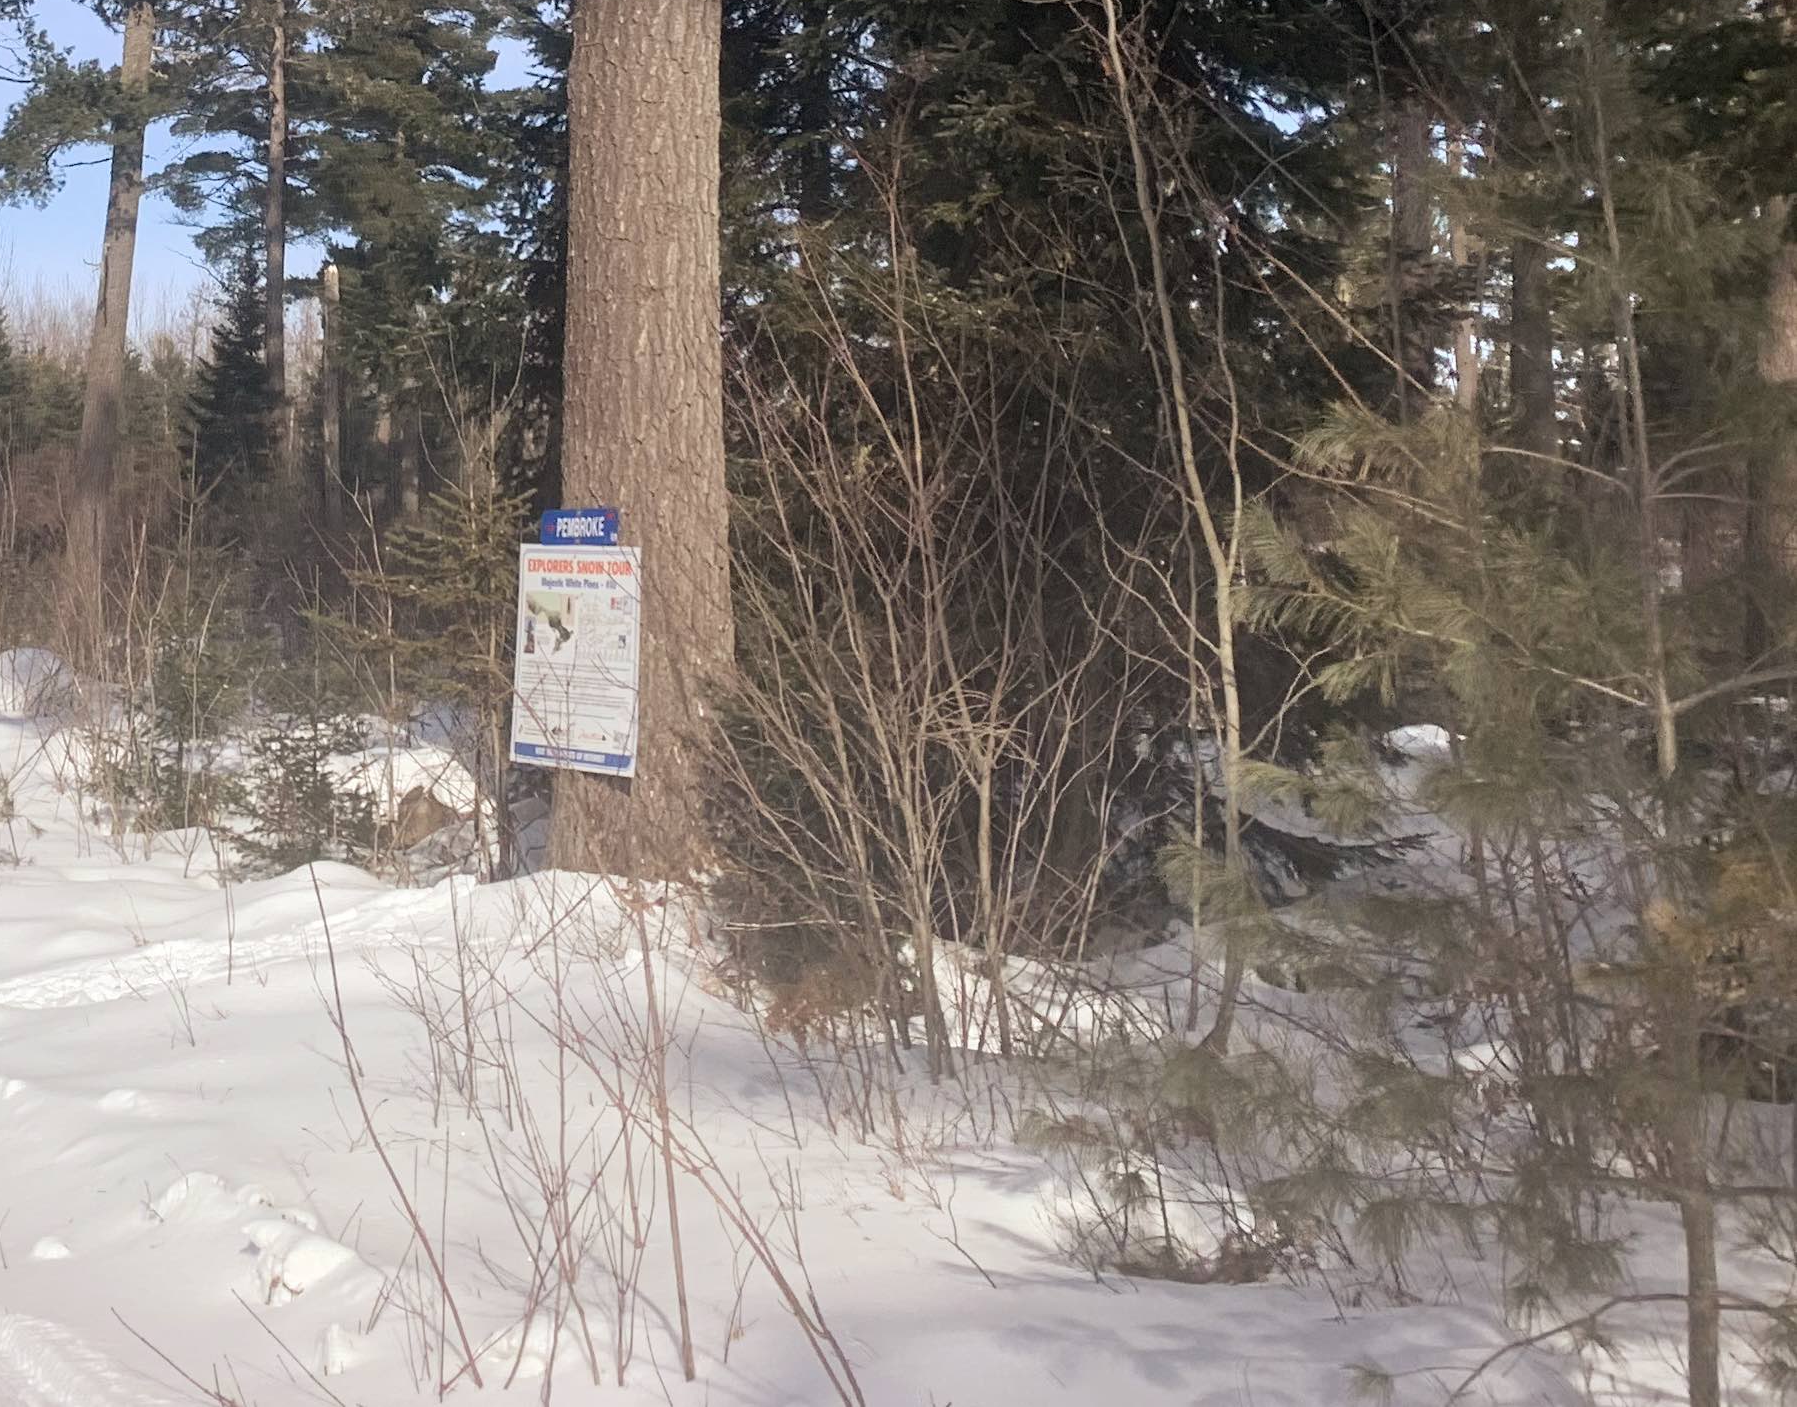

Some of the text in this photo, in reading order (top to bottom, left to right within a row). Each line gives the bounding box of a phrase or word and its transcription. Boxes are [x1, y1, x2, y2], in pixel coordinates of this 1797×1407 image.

[556, 516, 605, 538] PEMBROKE
[528, 558, 633, 576] EXPLORERS SNOW TOUR
[565, 578, 582, 588] White
